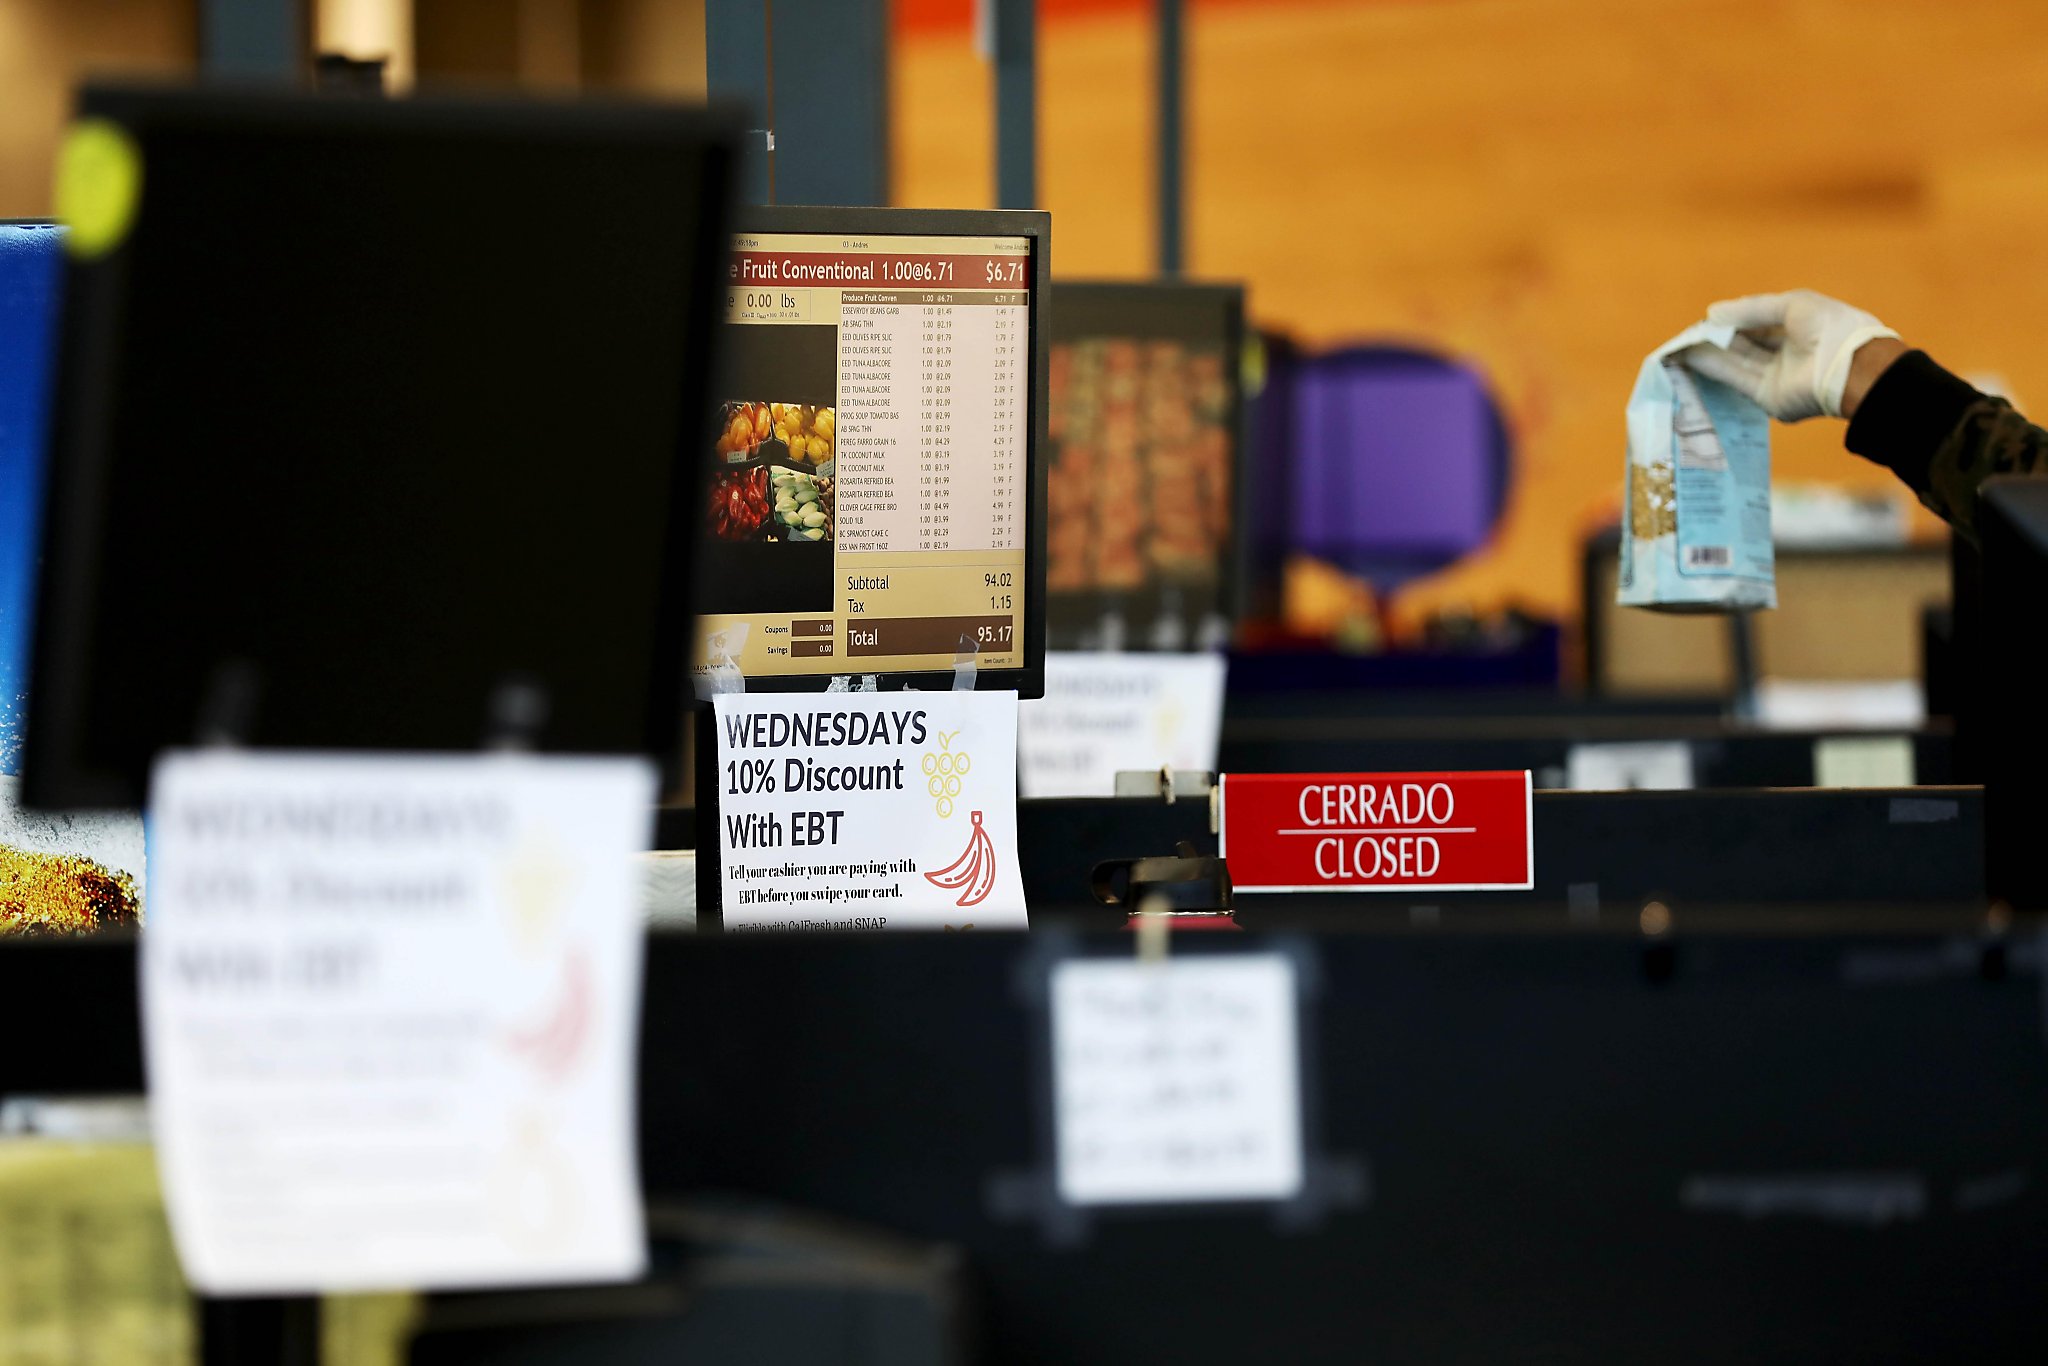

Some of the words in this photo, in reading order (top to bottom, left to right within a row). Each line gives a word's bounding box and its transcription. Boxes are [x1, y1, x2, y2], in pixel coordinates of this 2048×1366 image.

[743, 259, 778, 278] Fruit
[782, 260, 874, 280] Conventional
[882, 262, 954, 282] 1.00@6.71
[986, 260, 1023, 283] $6.71
[747, 294, 771, 307] 0.00
[781, 294, 795, 308] lbs
[843, 294, 863, 302] Produce
[865, 294, 877, 302] Fruit
[878, 294, 897, 302] Conven
[848, 575, 889, 590] Subtotal
[985, 573, 1011, 587] 94.02
[848, 599, 864, 613] Tax
[991, 596, 1011, 609] 1.15
[819, 624, 832, 632] 0.00
[849, 629, 878, 646] Total
[978, 626, 1012, 642] 95.17
[768, 647, 788, 655] Savings
[819, 645, 831, 653] 0.00
[725, 711, 926, 748] WEDNESDAYS
[728, 759, 776, 794] 10%
[785, 758, 903, 792] Discount
[1299, 782, 1455, 825] CERRADO
[727, 813, 783, 848] With
[791, 811, 844, 846] EBT
[1315, 836, 1441, 880] CLOSED
[729, 865, 745, 879] Tell
[746, 866, 768, 882] your
[769, 863, 805, 877] cashier
[807, 864, 827, 879] you
[829, 864, 848, 875] are
[850, 862, 888, 878] paying
[889, 859, 915, 873] with
[739, 890, 756, 904] EBT
[757, 888, 788, 903] before
[789, 890, 809, 905] you
[811, 887, 842, 903] swipe
[844, 888, 871, 902] your
[872, 885, 902, 899] card.
[788, 920, 830, 931] CalFresh
[834, 919, 852, 930] and
[855, 917, 886, 930] SNAP
